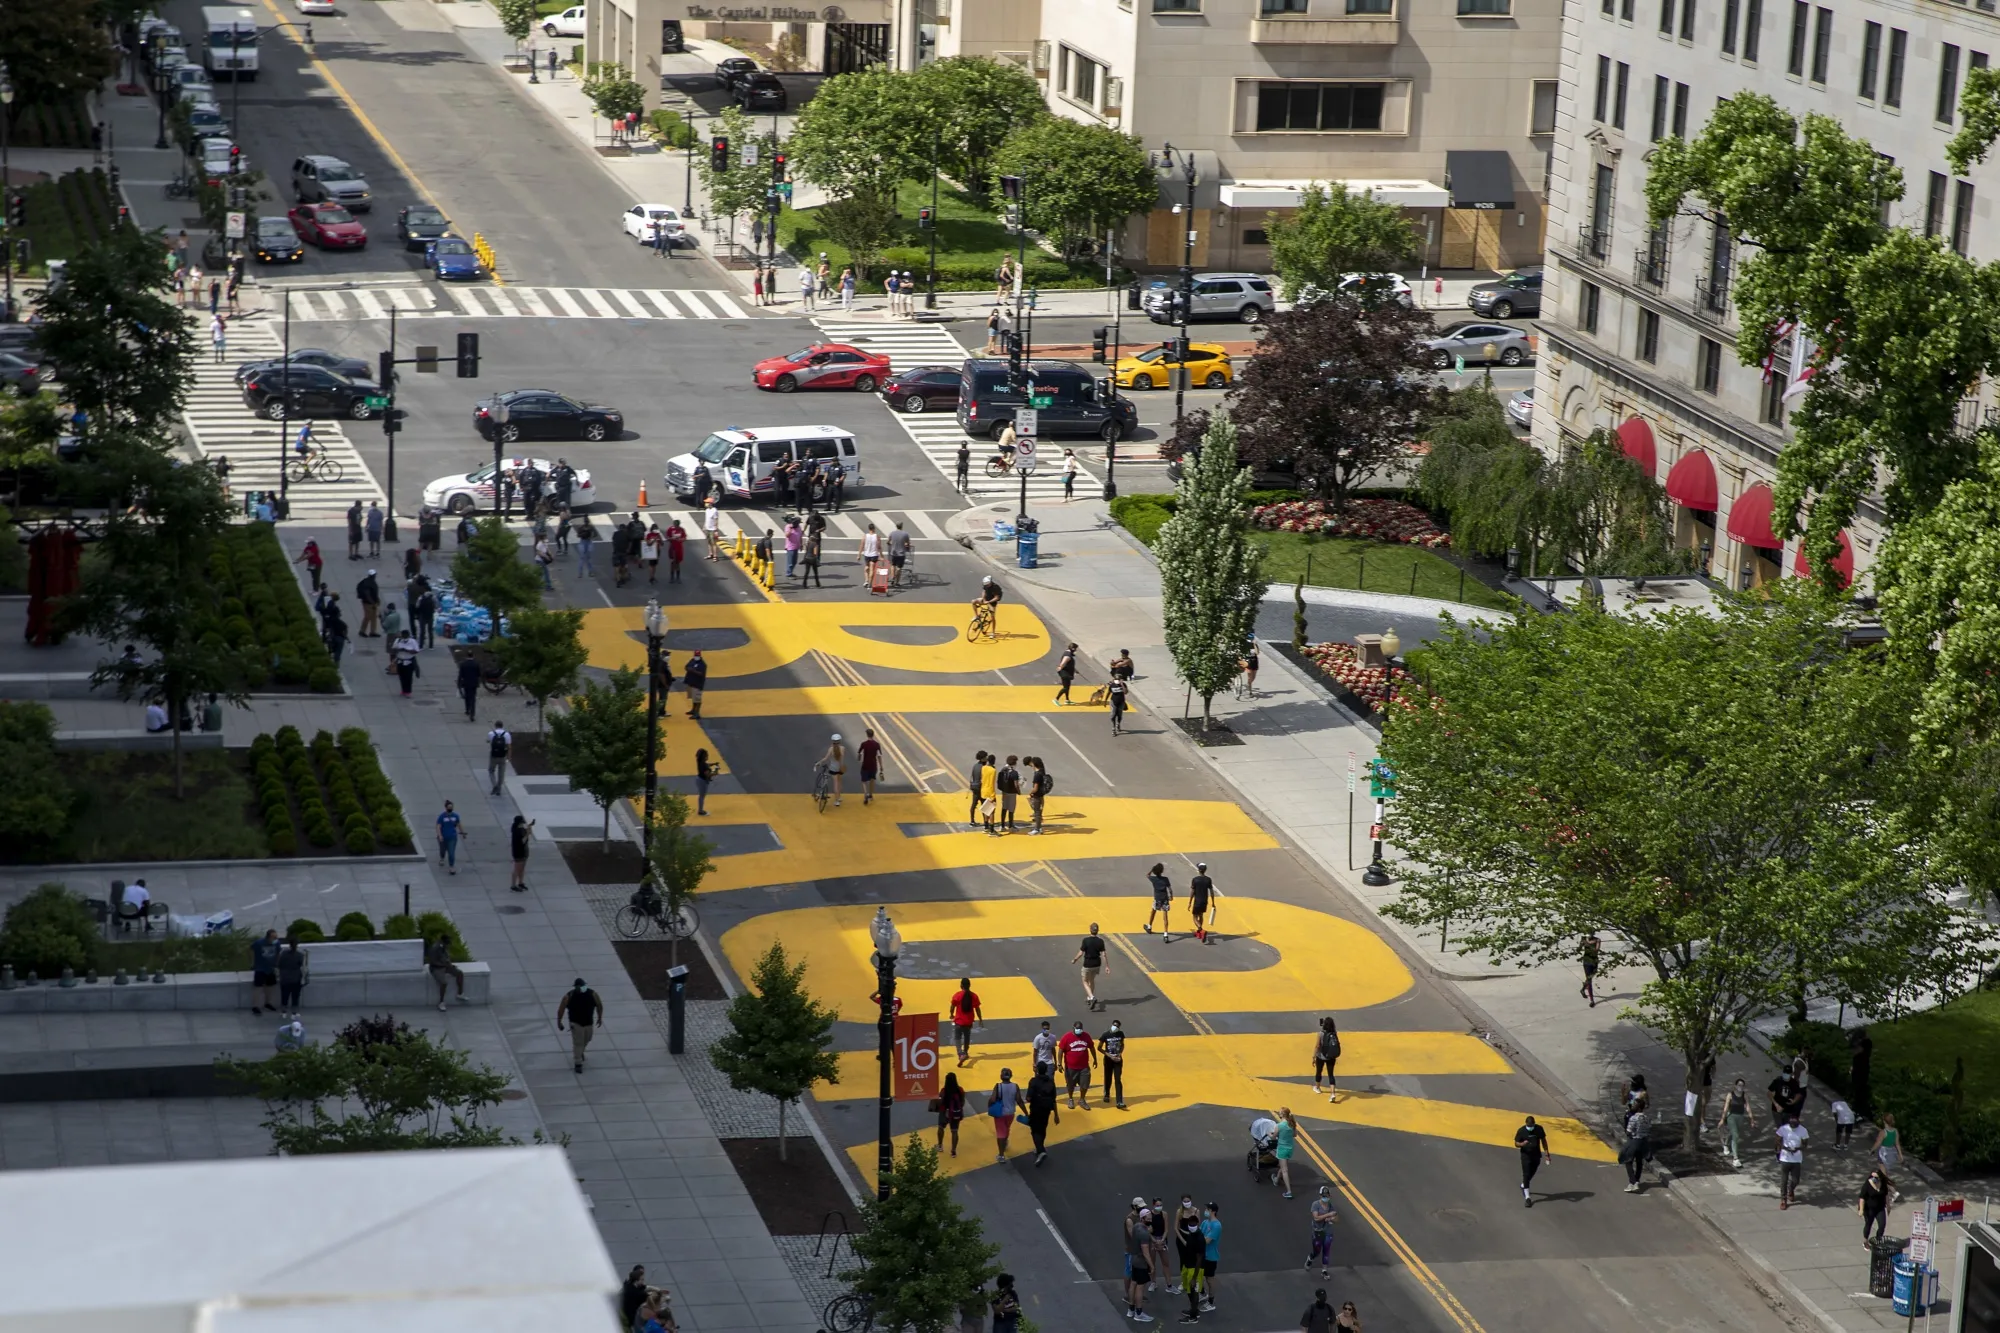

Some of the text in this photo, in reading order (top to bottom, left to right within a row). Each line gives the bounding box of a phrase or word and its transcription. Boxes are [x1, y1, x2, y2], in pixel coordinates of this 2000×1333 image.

[686, 5, 816, 20] The Capital Hilton
